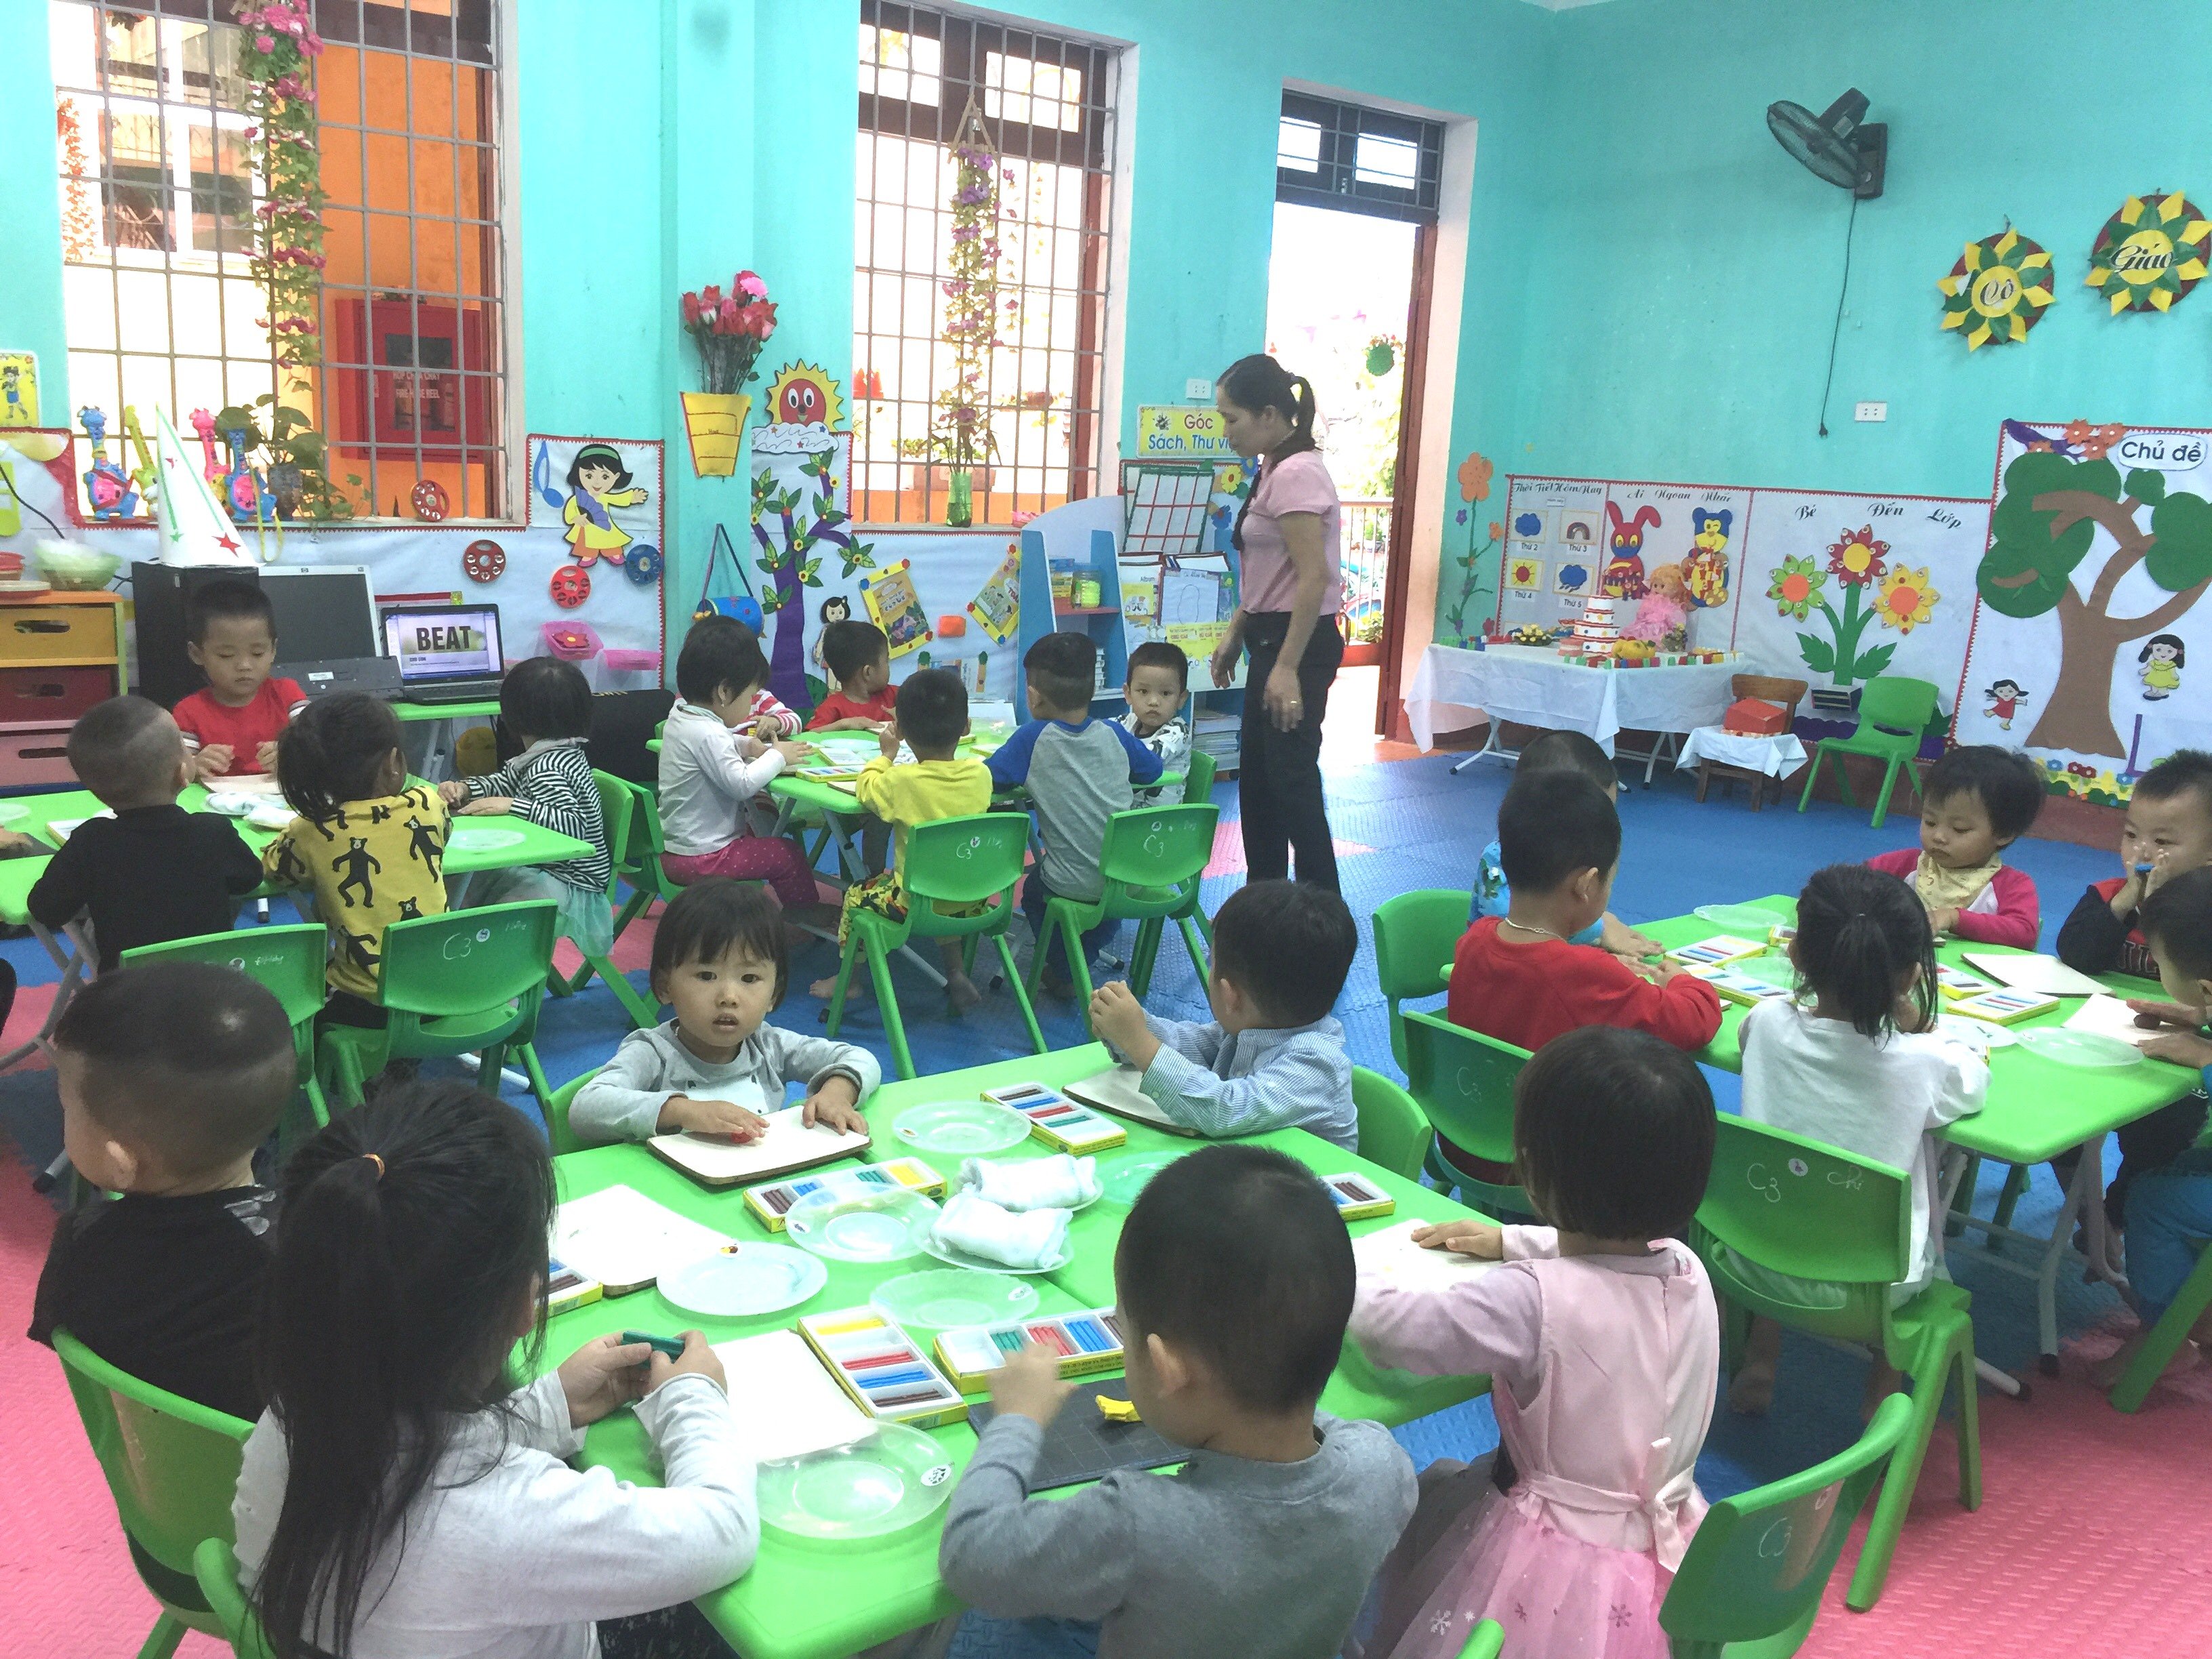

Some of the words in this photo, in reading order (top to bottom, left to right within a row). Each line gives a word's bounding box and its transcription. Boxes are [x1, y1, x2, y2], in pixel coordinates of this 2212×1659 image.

[2110, 243, 2173, 273] Giáo
[1184, 413, 1214, 430] Góc
[1148, 434, 1187, 451] Sách,
[1191, 434, 1215, 449] Thư
[2121, 439, 2165, 460] Chủ
[2171, 442, 2202, 462] đề
[1795, 504, 1817, 520] Bé
[1867, 501, 1905, 517] Đến
[1925, 508, 1962, 529] Lớp
[415, 625, 471, 651] BEAT
